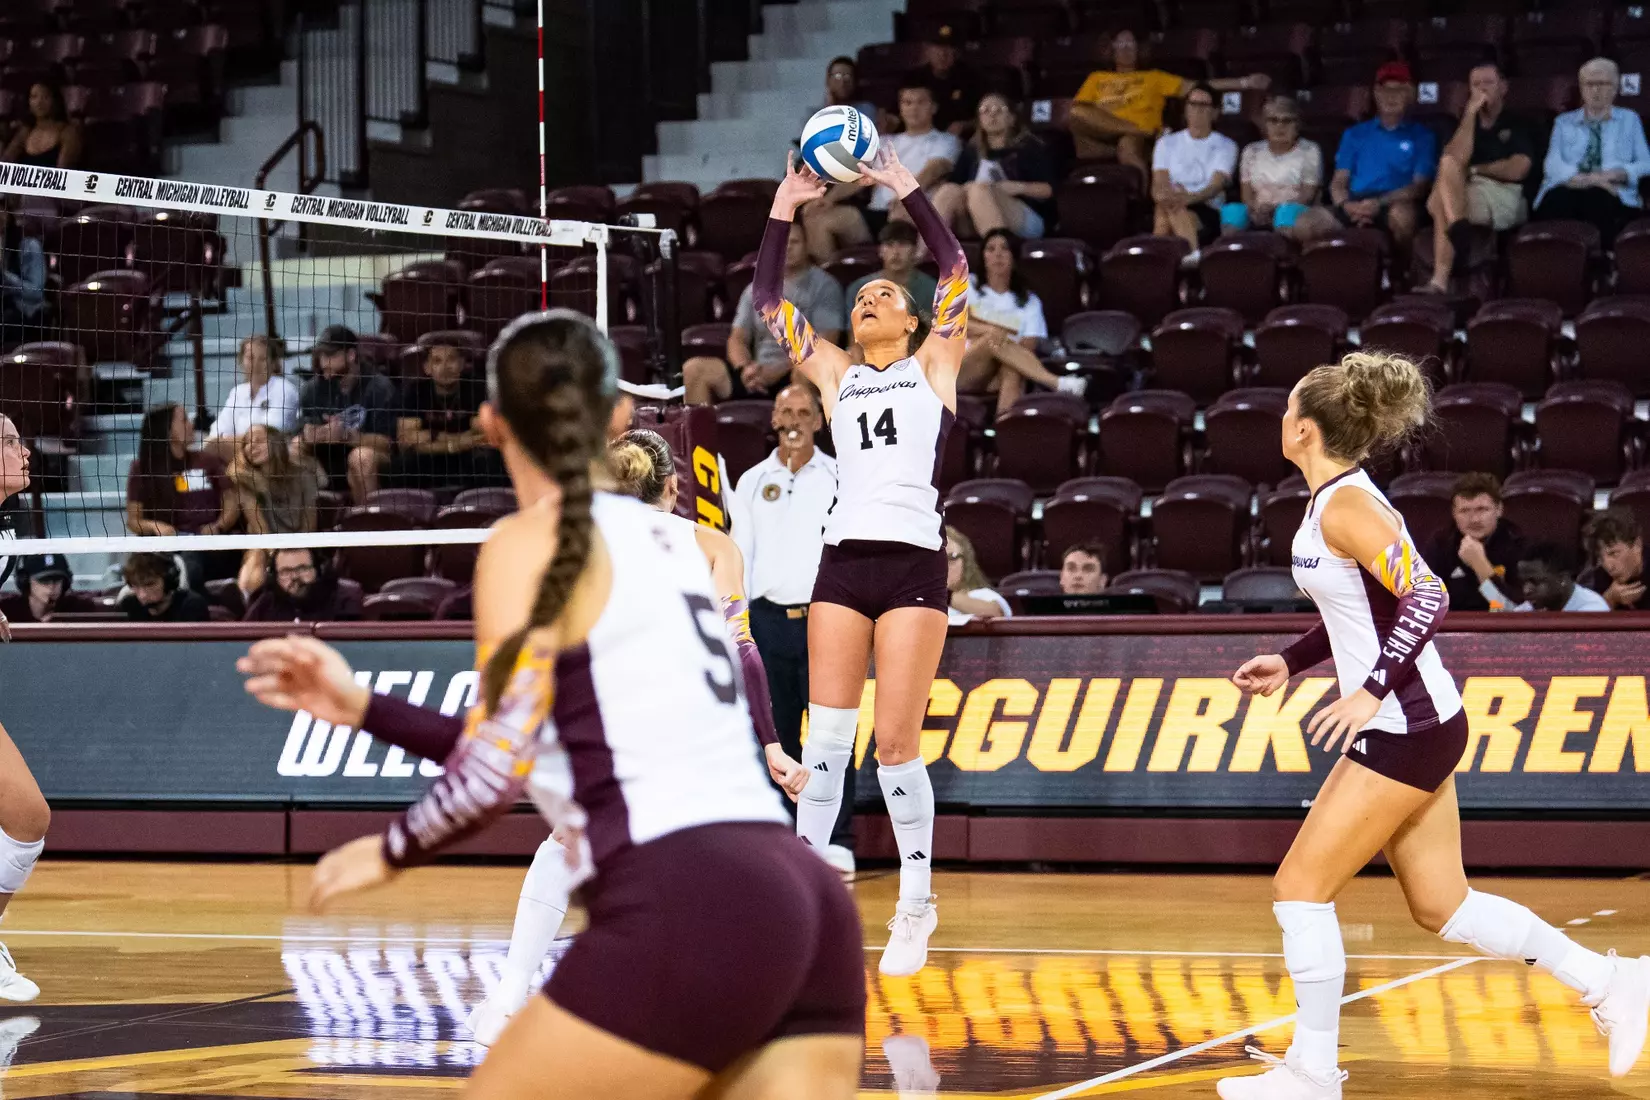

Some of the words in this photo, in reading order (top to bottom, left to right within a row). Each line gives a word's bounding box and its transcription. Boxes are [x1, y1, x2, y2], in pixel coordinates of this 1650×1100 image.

[848, 107, 858, 142] molte
[10, 166, 68, 191] VOLLEYBALL
[115, 177, 153, 199] CENTRAL
[155, 181, 200, 205] MICHIGAN
[199, 186, 250, 209] VOLLEYBALL
[290, 196, 325, 216] CENTRAL
[326, 200, 365, 220] MICHIGAN
[365, 204, 409, 225] VOLLEYBALL
[445, 211, 477, 230] CENTRAL
[477, 214, 512, 233] MICHIGAN
[839, 381, 918, 402] Chippewas
[857, 407, 898, 450] 14
[683, 592, 737, 704] 5
